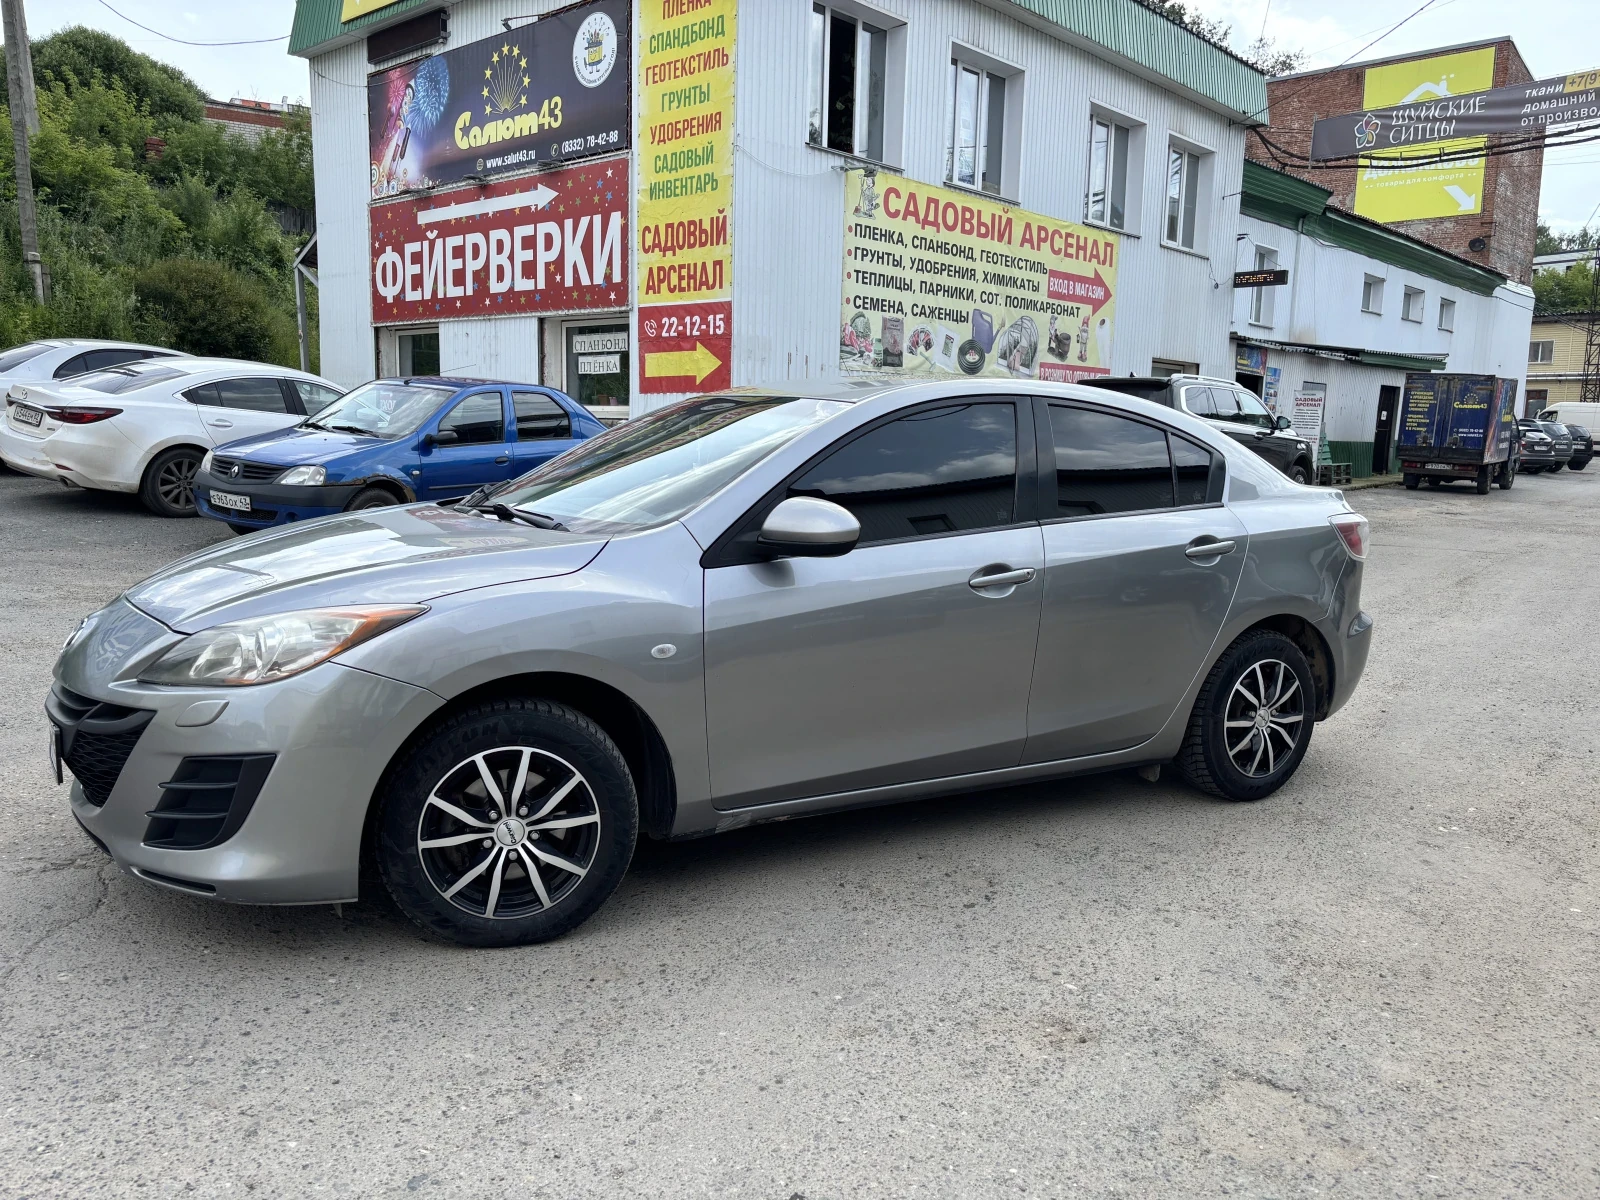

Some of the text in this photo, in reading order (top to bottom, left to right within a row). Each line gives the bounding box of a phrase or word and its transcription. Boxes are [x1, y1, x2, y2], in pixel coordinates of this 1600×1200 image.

[649, 14, 726, 54] СПАНДБОНД
[645, 46, 729, 86] ГЕОТЕКСТИЛЬ
[1569, 72, 1600, 88] +7(9
[661, 82, 711, 113] ГРУНТЫ
[1521, 89, 1595, 114] домашний
[1525, 84, 1563, 98] ткани
[454, 95, 562, 150] Салют43
[1392, 95, 1486, 125] ШУЙСКИЕ
[1521, 107, 1600, 126] от произво
[561, 130, 619, 155] (8332) 78-42-88
[650, 111, 722, 146] УДОБРЕНИЯ
[1389, 119, 1456, 144] СИТЦЫ
[486, 149, 536, 169] www.salut43.ru
[654, 141, 714, 174] САДОВЫЙ
[649, 172, 718, 201] ИНВЕНТАРЬ
[642, 208, 728, 257] САДОВЫЙ
[883, 186, 1114, 268] САДОВЫЙ АРСЕНАЛ
[375, 210, 622, 304] ФЕЙЕРВЕРКИ
[854, 222, 1048, 275] ПЛЕНКА, СПАНБОНД, ГЕОТЕКСТИЛЬ
[645, 259, 724, 295] АРСЕНАЛ
[854, 246, 1040, 293] ГРУНТЫ, УДОБРЕНИЯ, ХИМИКАТЫ
[854, 270, 1080, 319] ТЕПЛИЦЫ, ПАРНИКИ, СОТ. ПОЛИКАРБОНАТ
[1049, 276, 1105, 301] ВХОД В МАГАЗИН
[853, 294, 907, 317] СЕМЕНА,
[910, 303, 969, 325] САЖЕНЦЫ
[661, 313, 725, 338] 22-12-15
